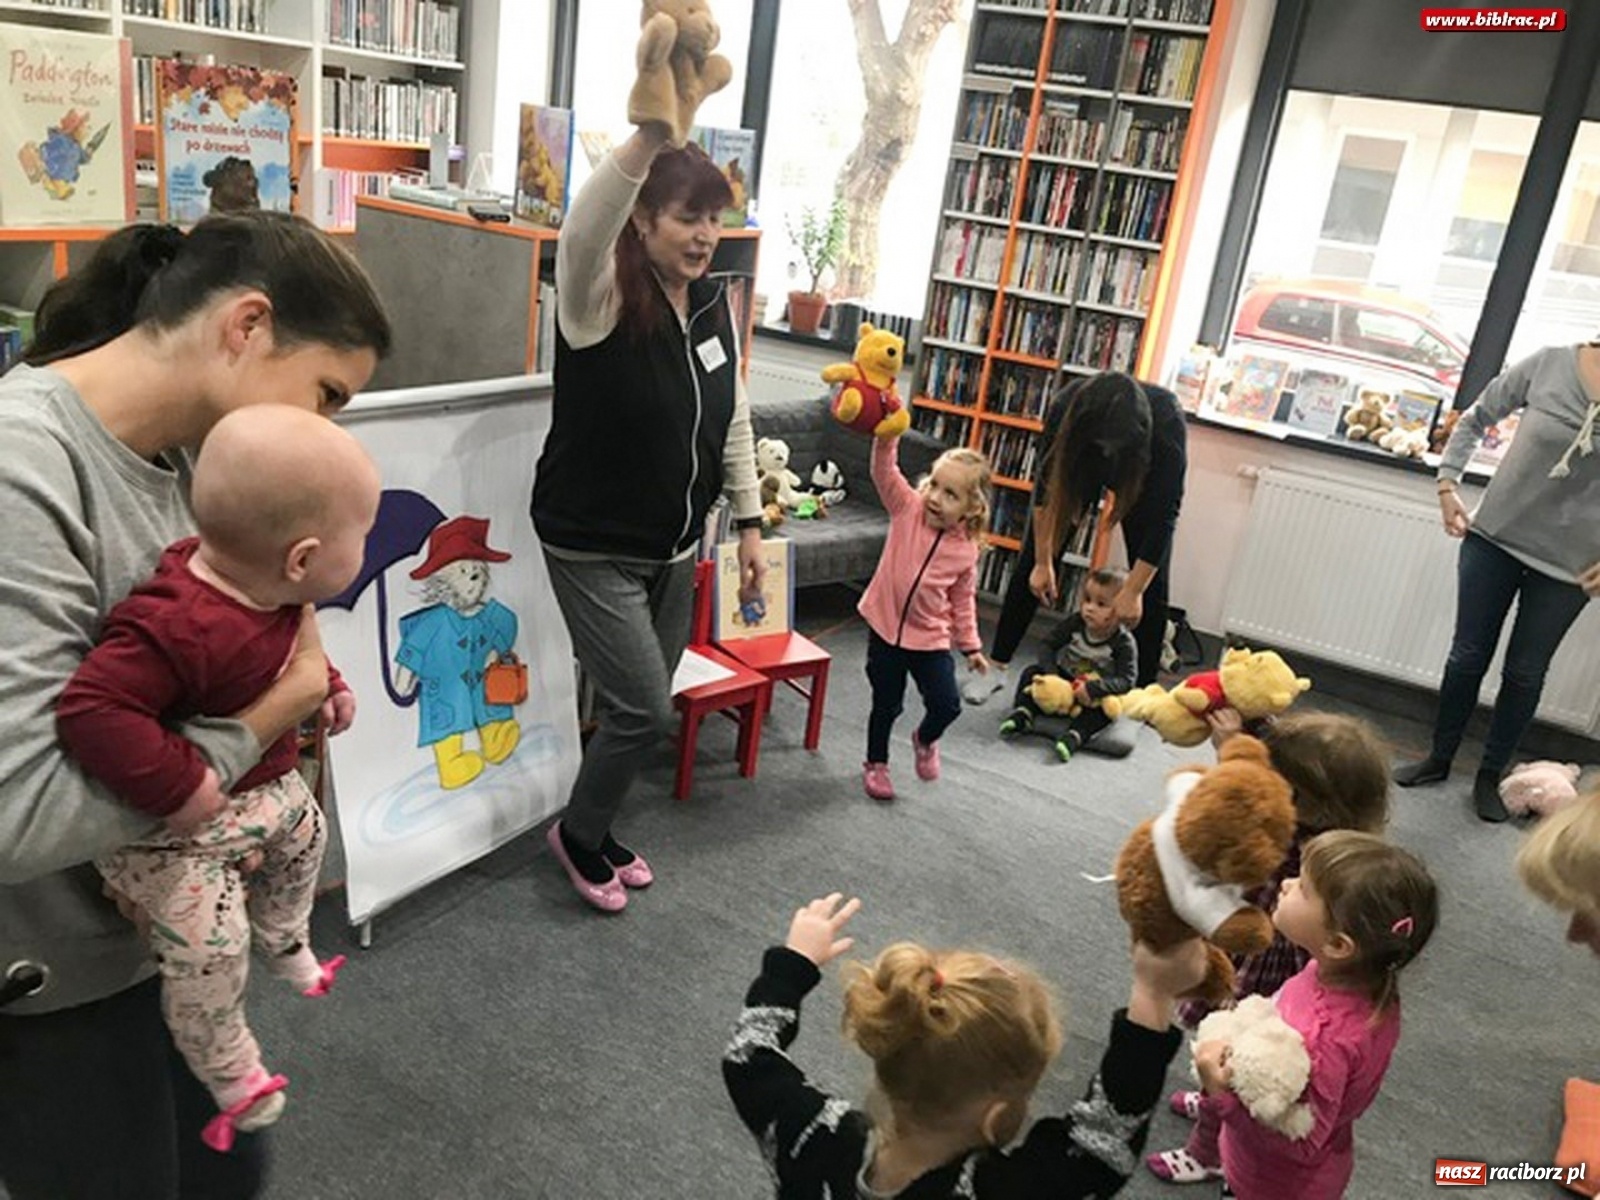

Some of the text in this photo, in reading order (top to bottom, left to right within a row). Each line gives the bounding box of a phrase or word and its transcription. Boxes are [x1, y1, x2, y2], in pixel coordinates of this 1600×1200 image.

[9, 49, 113, 95] Paddington
[170, 118, 198, 133] Stare
[186, 139, 200, 154] po
